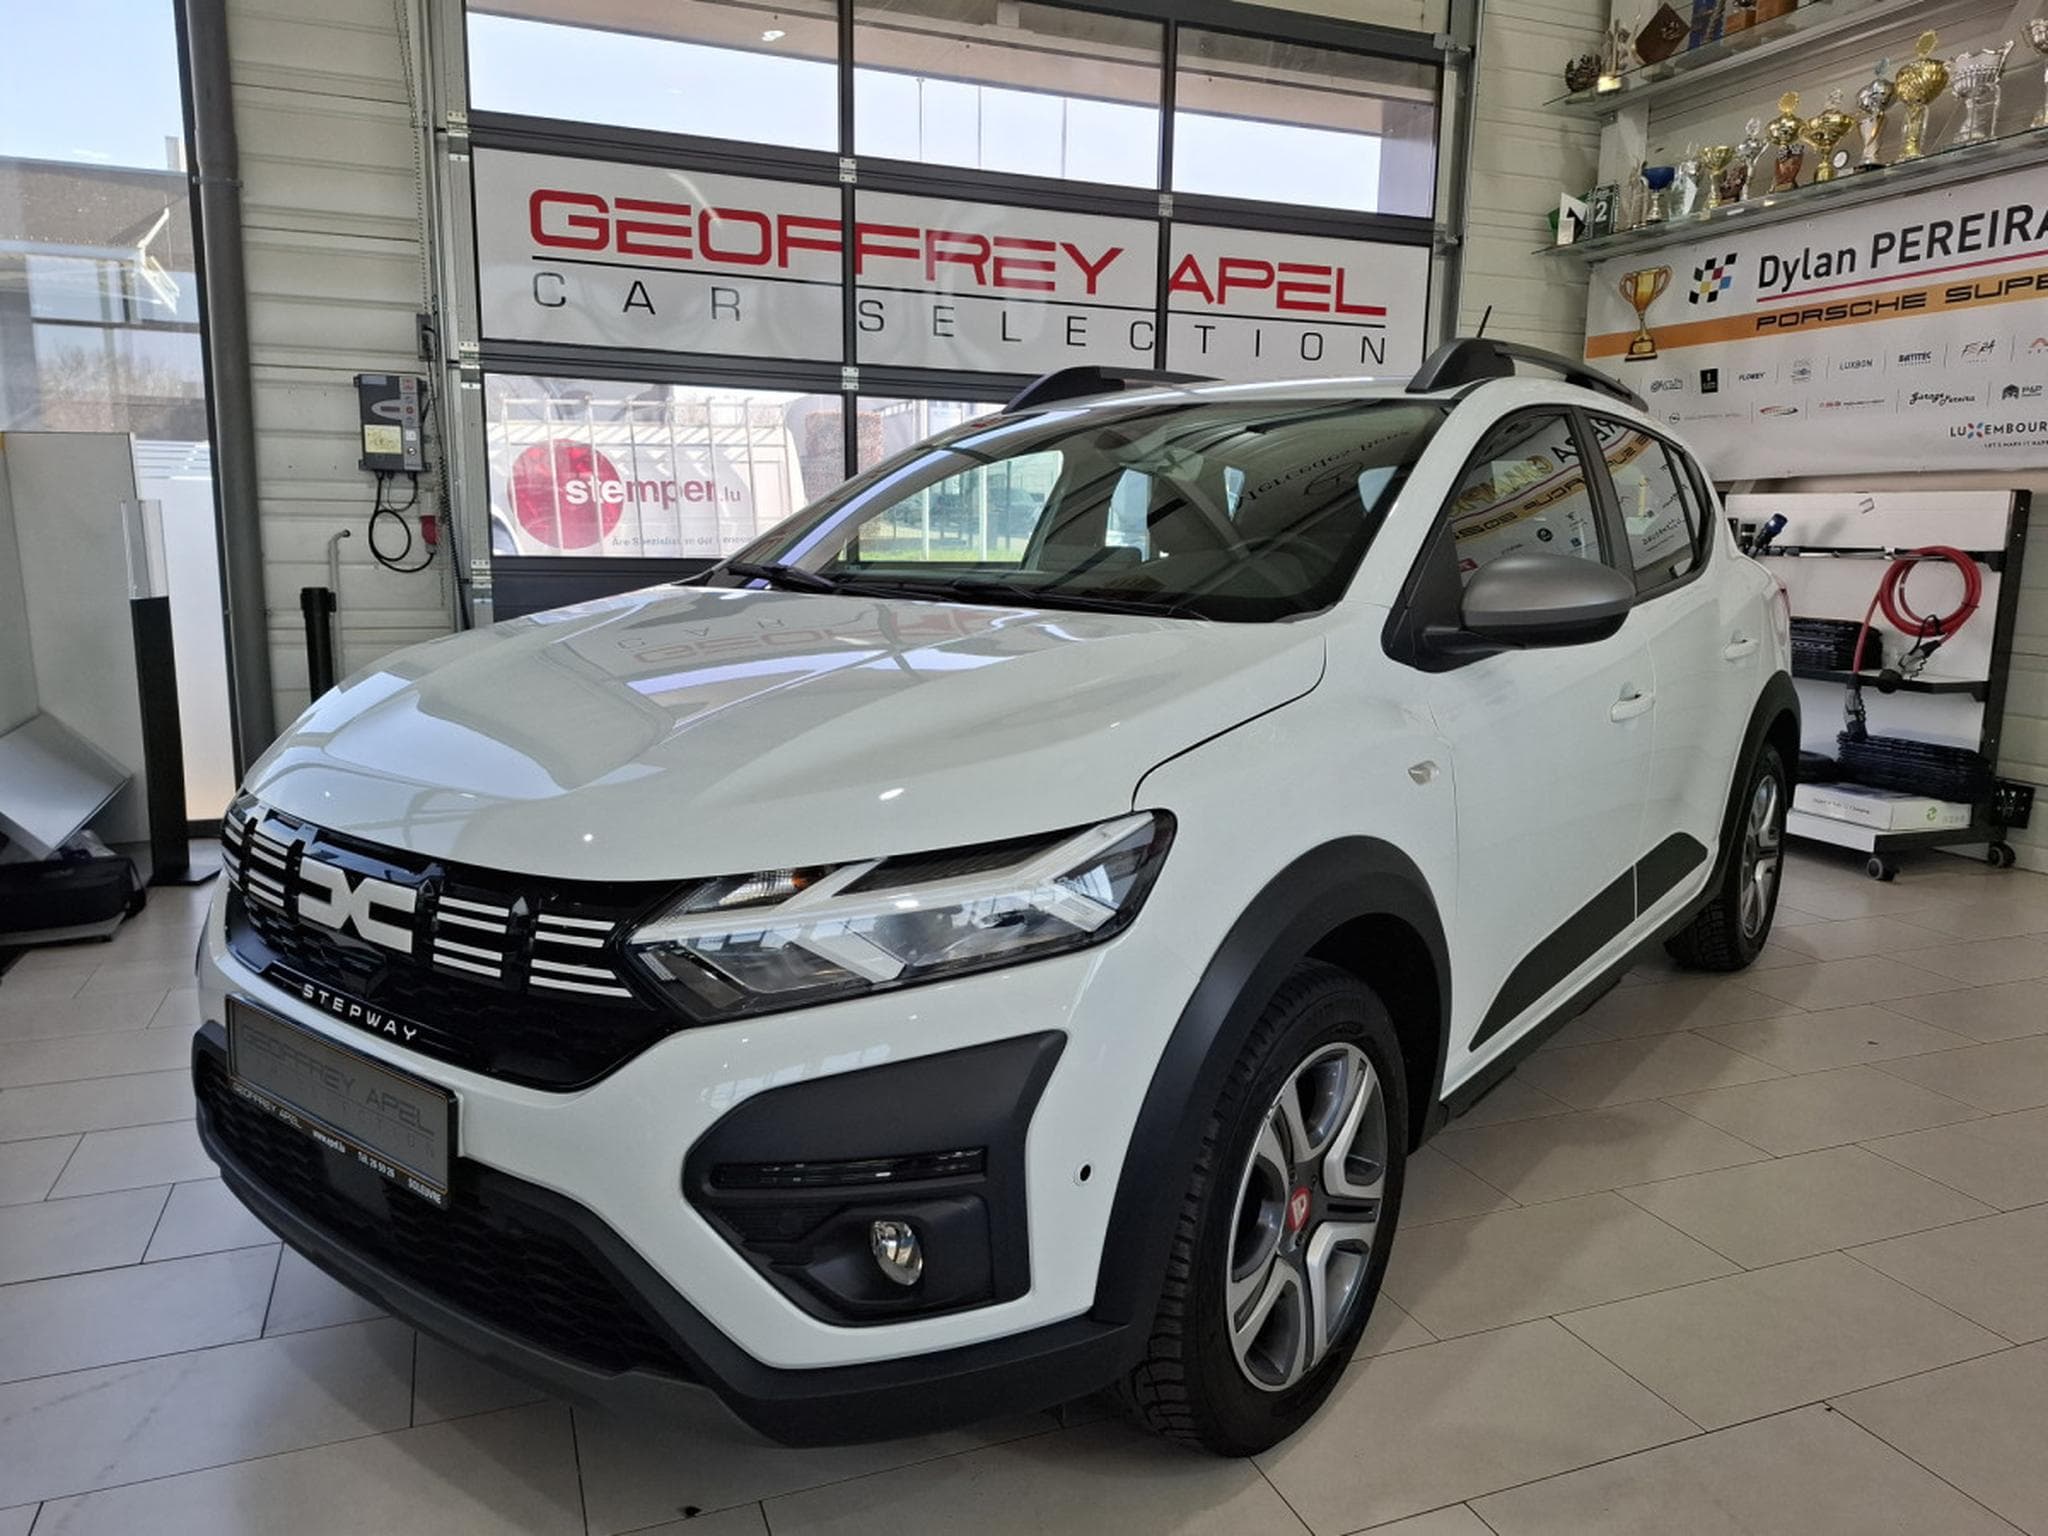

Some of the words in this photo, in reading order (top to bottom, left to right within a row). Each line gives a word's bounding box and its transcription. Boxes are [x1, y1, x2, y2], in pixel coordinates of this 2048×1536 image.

[529, 188, 1124, 295] GEOFFREY
[1168, 253, 1387, 316] APEL
[1758, 247, 1857, 293] Dylan
[532, 271, 741, 322] CAR
[858, 299, 1386, 365] SELECTION
[1756, 291, 1928, 331] PORSCHE
[302, 983, 417, 1041] STEPWAY
